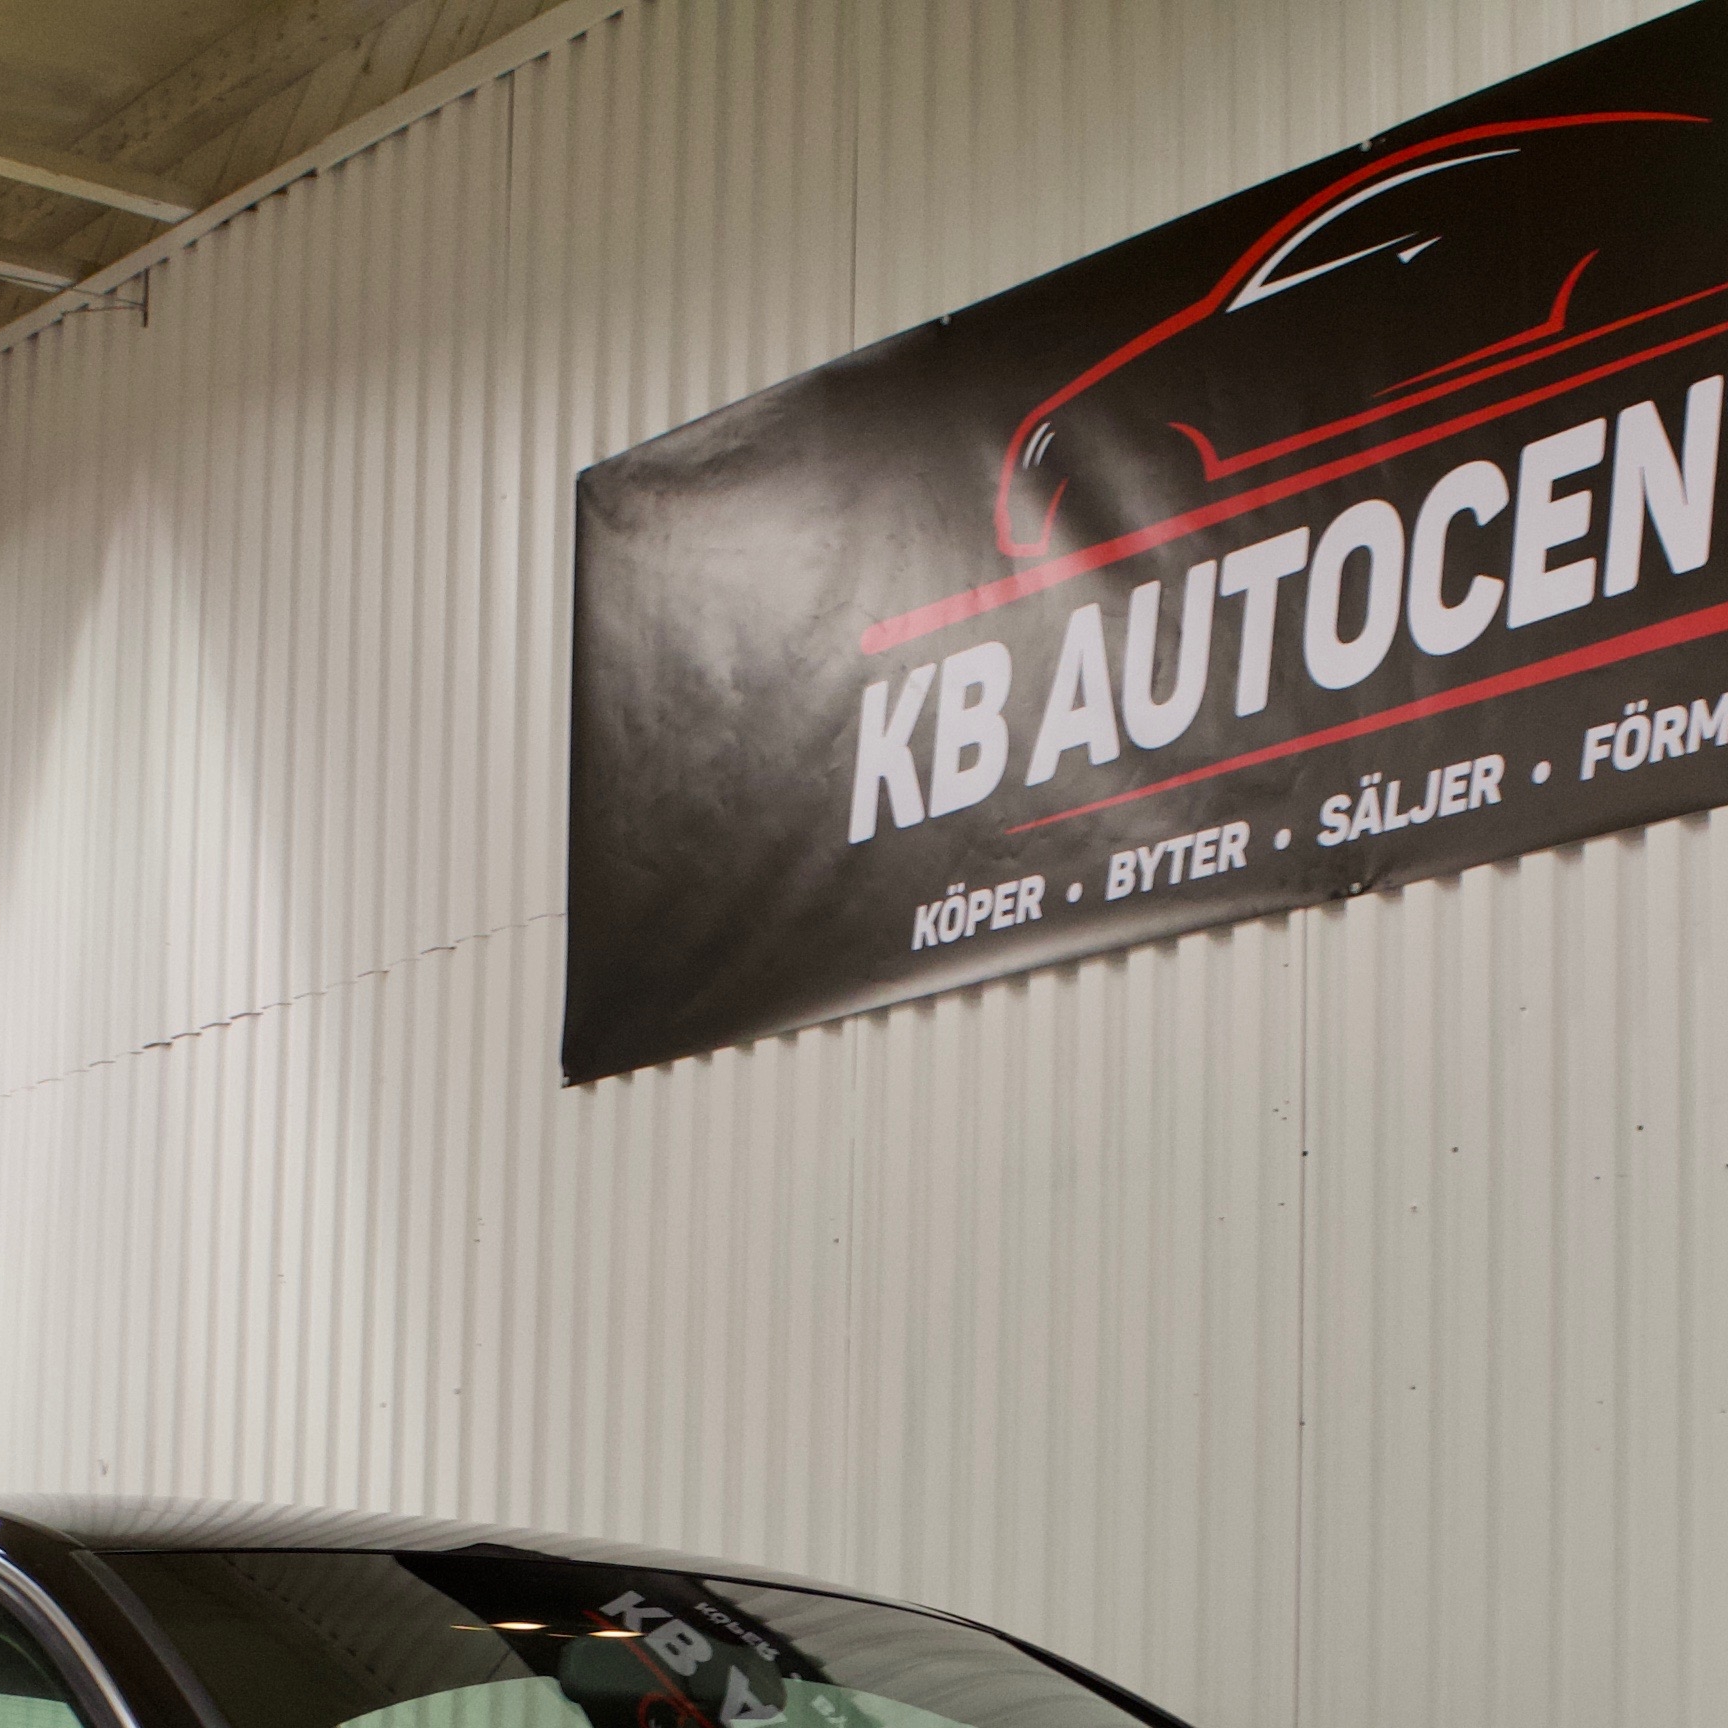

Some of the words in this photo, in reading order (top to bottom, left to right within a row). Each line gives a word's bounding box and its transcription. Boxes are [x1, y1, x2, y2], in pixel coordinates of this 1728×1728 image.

[848, 640, 1013, 844] KB
[911, 873, 1046, 951] KÖPER
[1105, 820, 1251, 901] BYTER
[1316, 754, 1506, 847] SÄLJER
